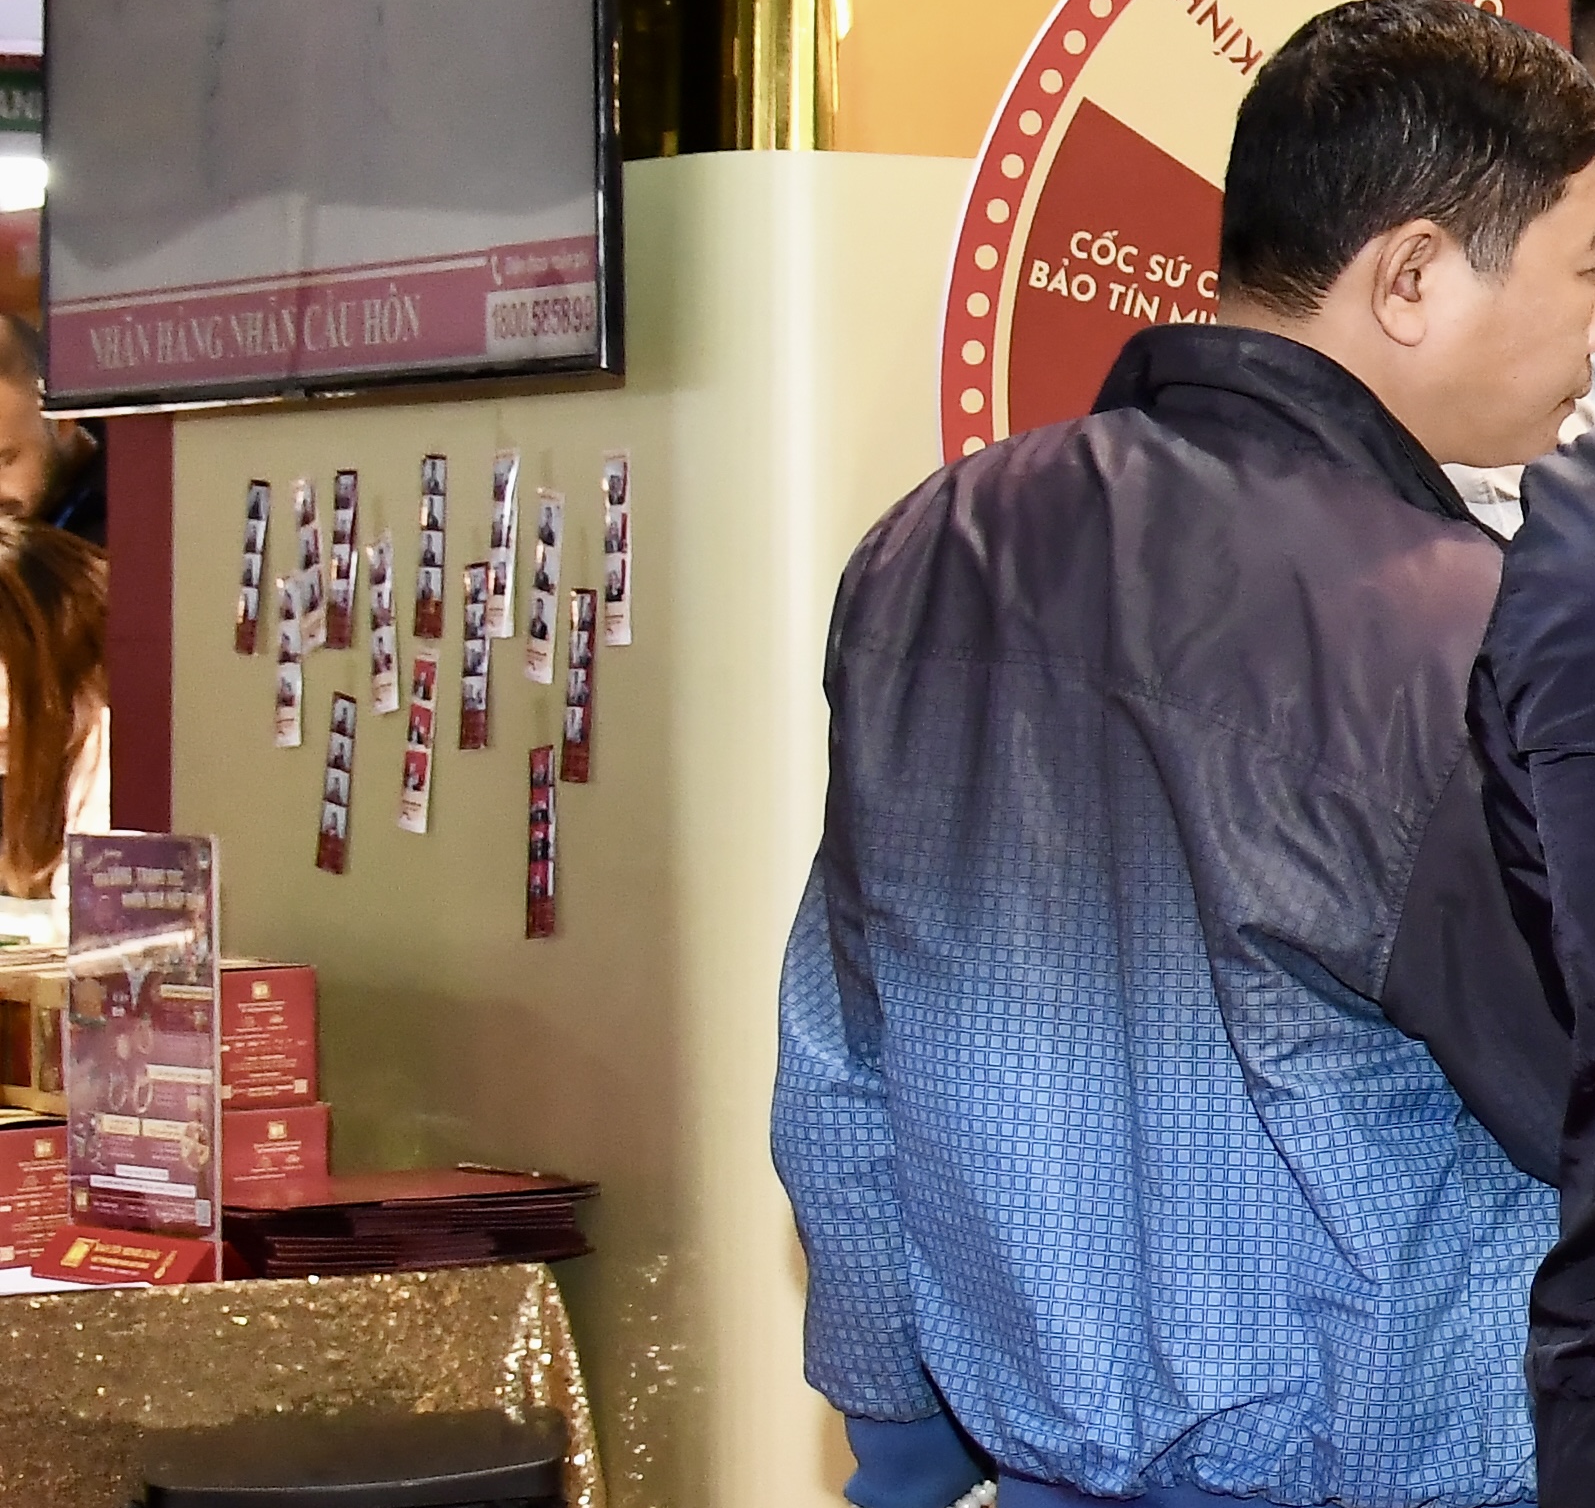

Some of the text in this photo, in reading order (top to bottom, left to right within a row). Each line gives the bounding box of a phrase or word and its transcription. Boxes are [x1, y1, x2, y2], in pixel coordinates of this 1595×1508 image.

[1069, 229, 1137, 273] CỐC
[1146, 256, 1193, 288] SỨ
[362, 282, 422, 345] HÔN
[1028, 257, 1098, 303] BẢO
[1108, 280, 1159, 325] TÍN
